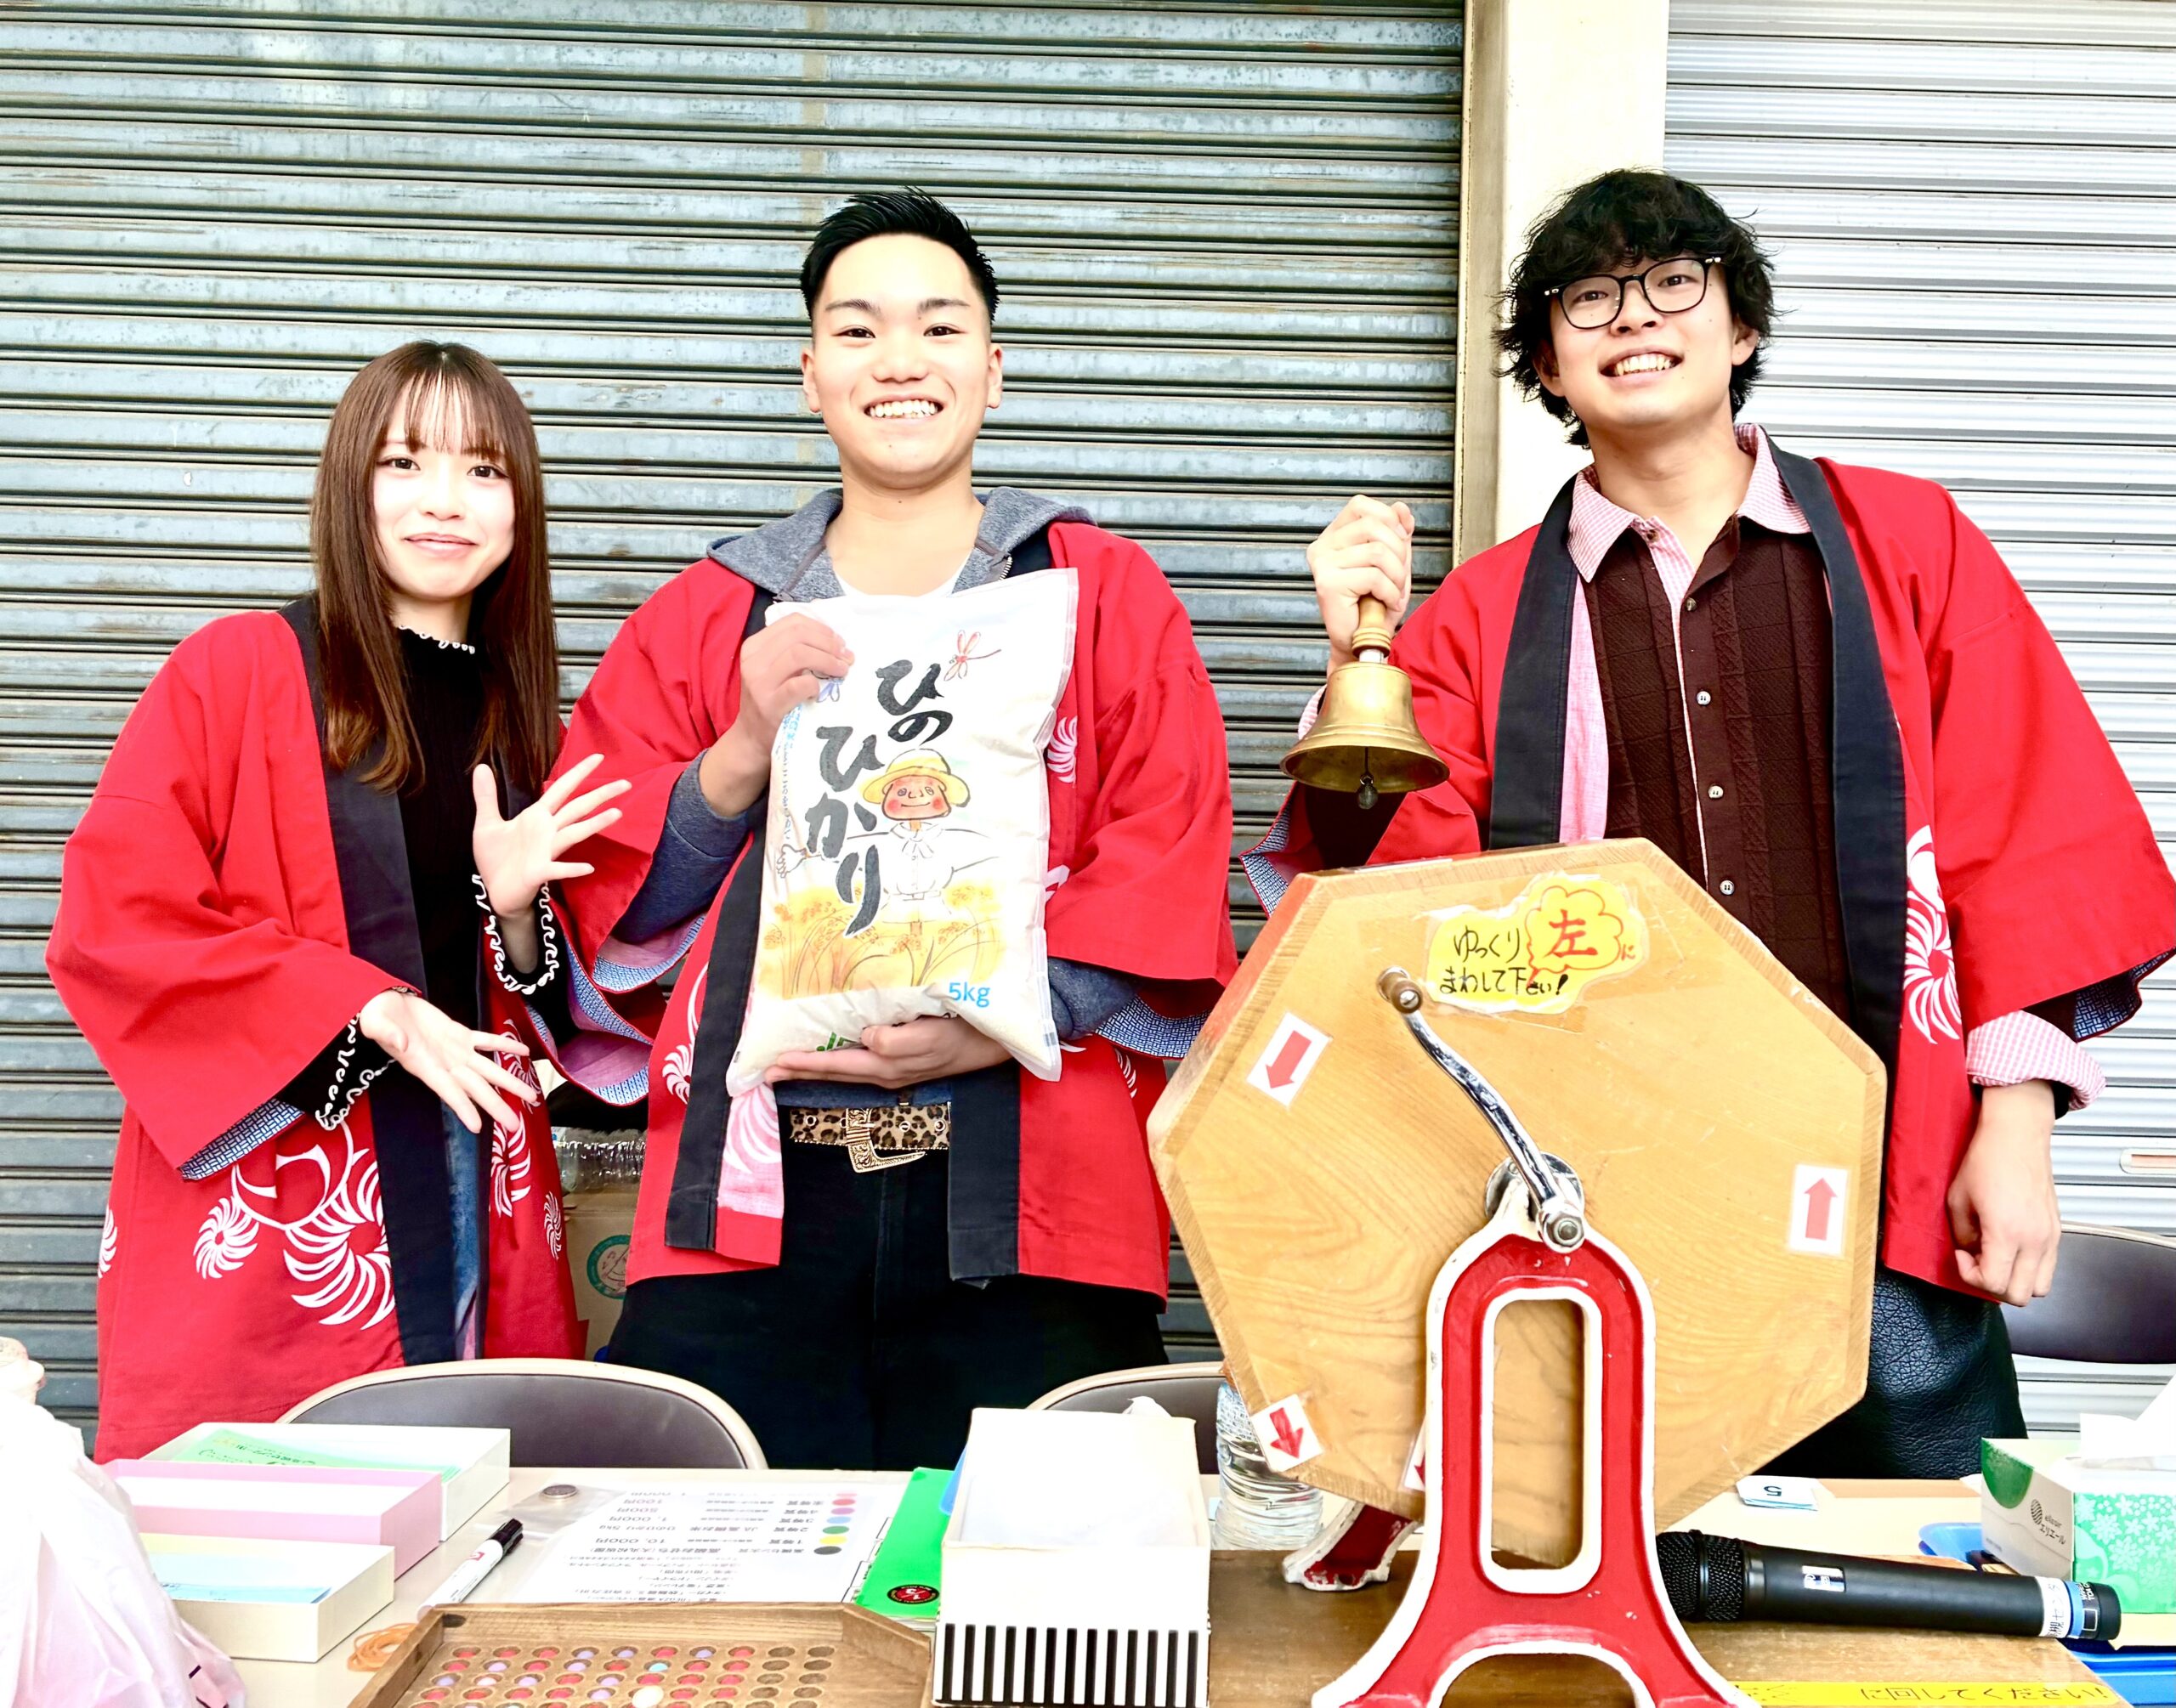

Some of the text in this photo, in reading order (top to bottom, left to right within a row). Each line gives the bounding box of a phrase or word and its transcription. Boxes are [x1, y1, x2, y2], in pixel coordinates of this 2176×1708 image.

[876, 659, 953, 747] ひの
[804, 725, 884, 937] ひかり
[1453, 925, 1521, 964] ゆっくり
[1543, 908, 1598, 959] 左
[948, 981, 991, 1009] 5kg
[1763, 1485, 1782, 1497] 5
[1860, 1687, 2109, 1700] に回してください!
